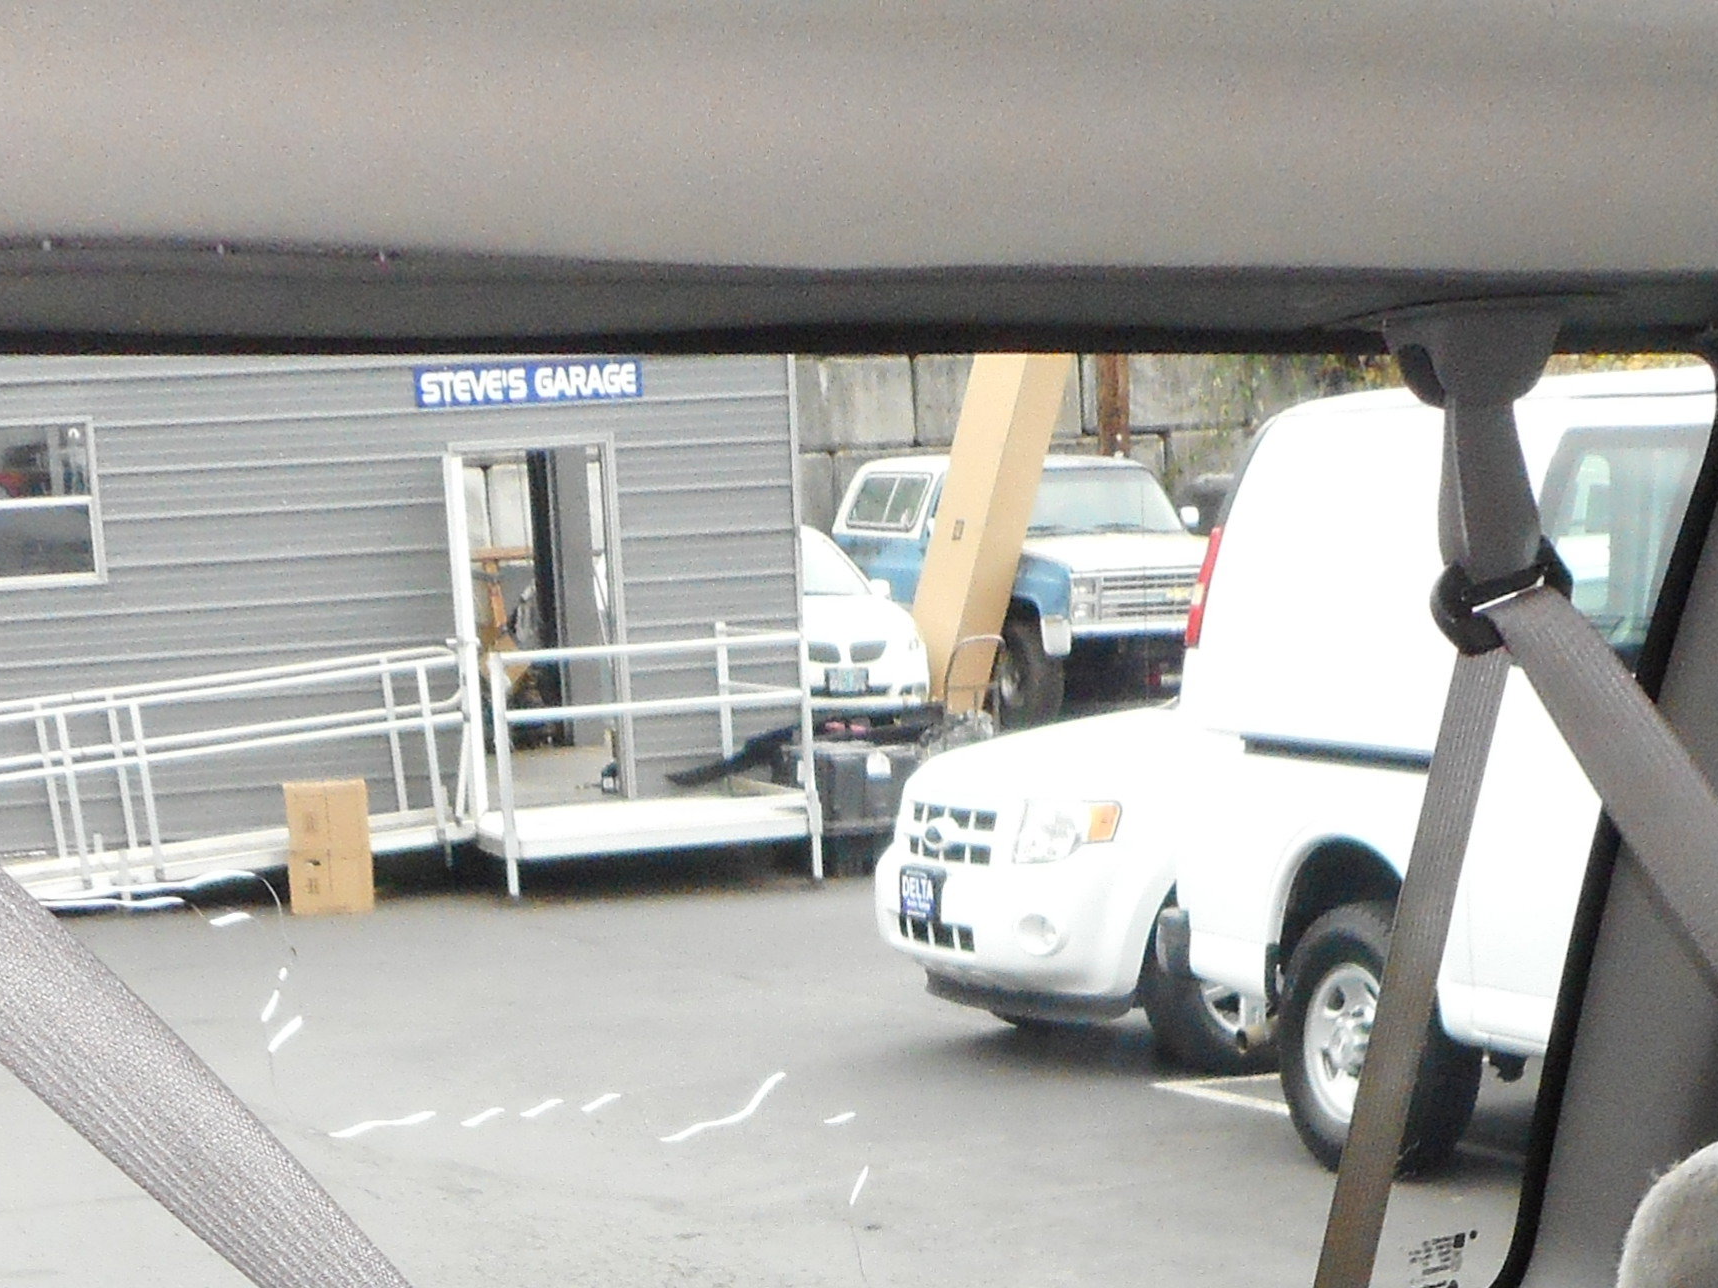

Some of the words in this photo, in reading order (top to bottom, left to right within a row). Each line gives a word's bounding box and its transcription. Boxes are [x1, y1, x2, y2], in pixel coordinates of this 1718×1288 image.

[420, 367, 527, 404] STEVE'S
[534, 363, 637, 398] GARAGE
[901, 875, 934, 901] DELTA
